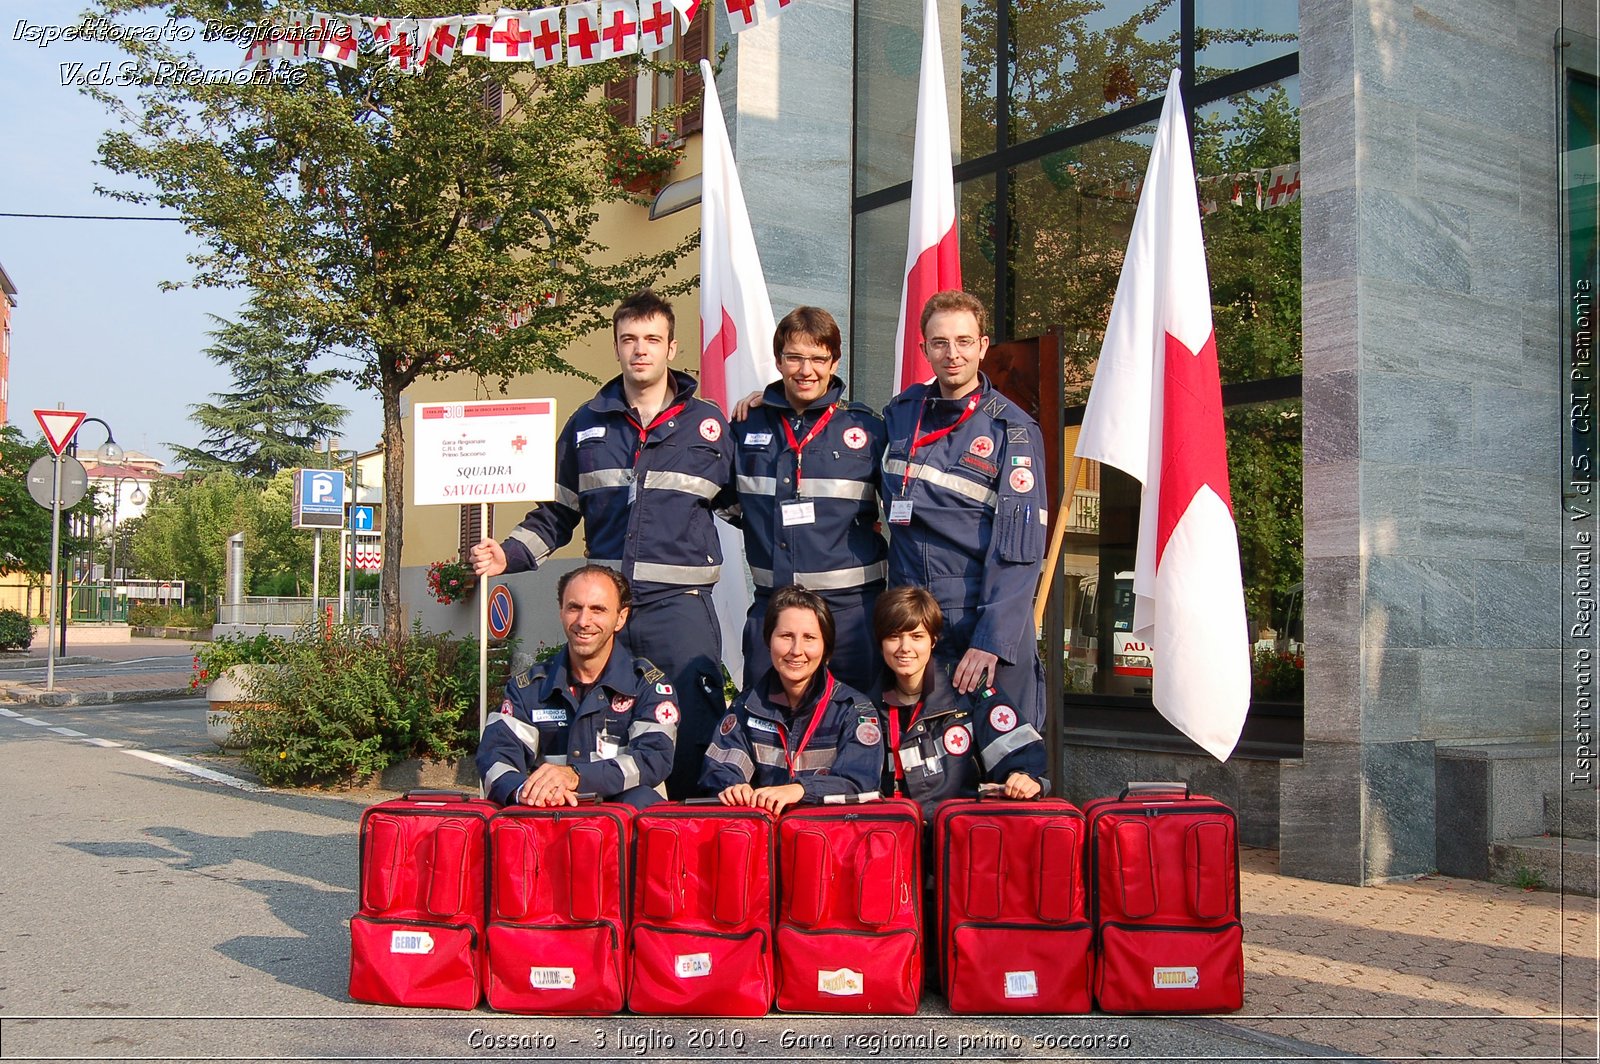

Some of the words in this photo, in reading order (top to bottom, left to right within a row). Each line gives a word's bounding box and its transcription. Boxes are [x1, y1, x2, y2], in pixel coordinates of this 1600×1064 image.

[456, 465, 512, 479] SQUADRA
[312, 479, 333, 503] P
[442, 482, 526, 497] SAVIGLIANO
[395, 936, 421, 949] GERBY
[1156, 971, 1187, 984] PATATA
